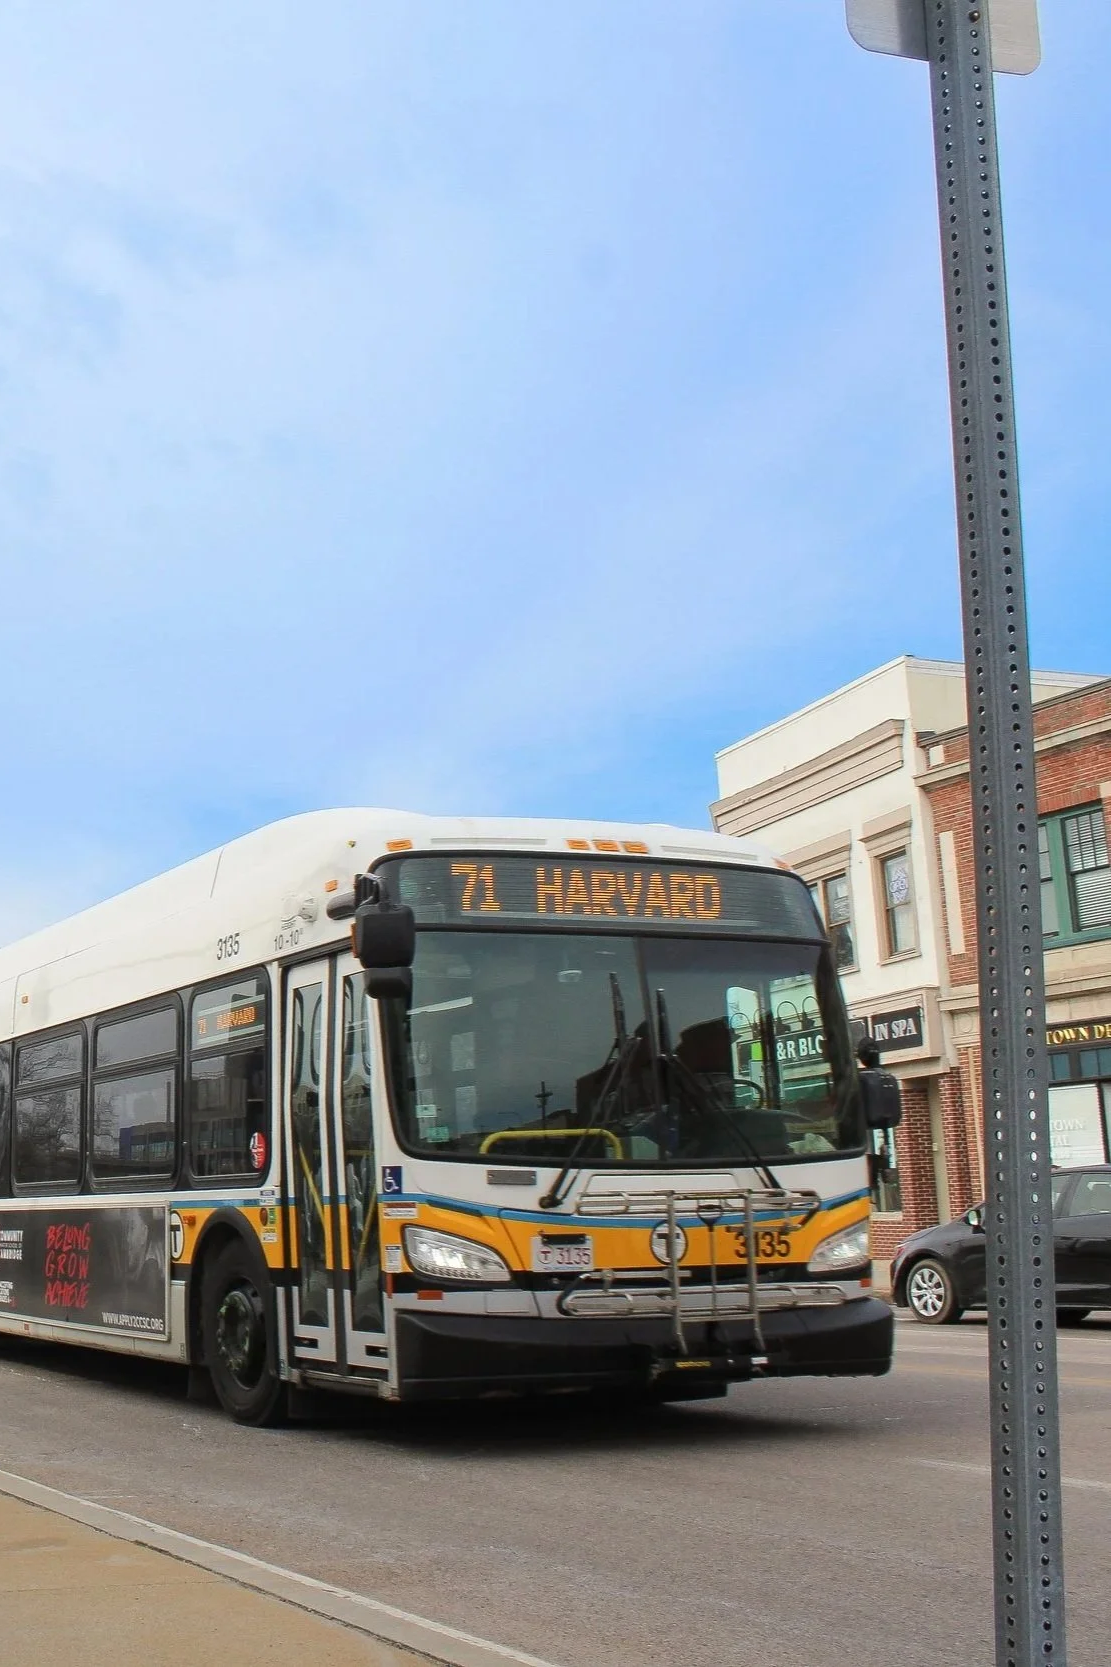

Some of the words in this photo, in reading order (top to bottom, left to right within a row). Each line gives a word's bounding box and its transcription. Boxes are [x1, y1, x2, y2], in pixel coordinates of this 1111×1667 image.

[450, 863, 501, 912] 71
[536, 866, 721, 920] HARVARD
[216, 932, 240, 961] 3135
[891, 1017, 918, 1039] SPA
[47, 1222, 91, 1252] BELONG
[734, 1231, 790, 1258] 3135
[45, 1250, 89, 1279] GROW
[556, 1247, 591, 1265] 3135
